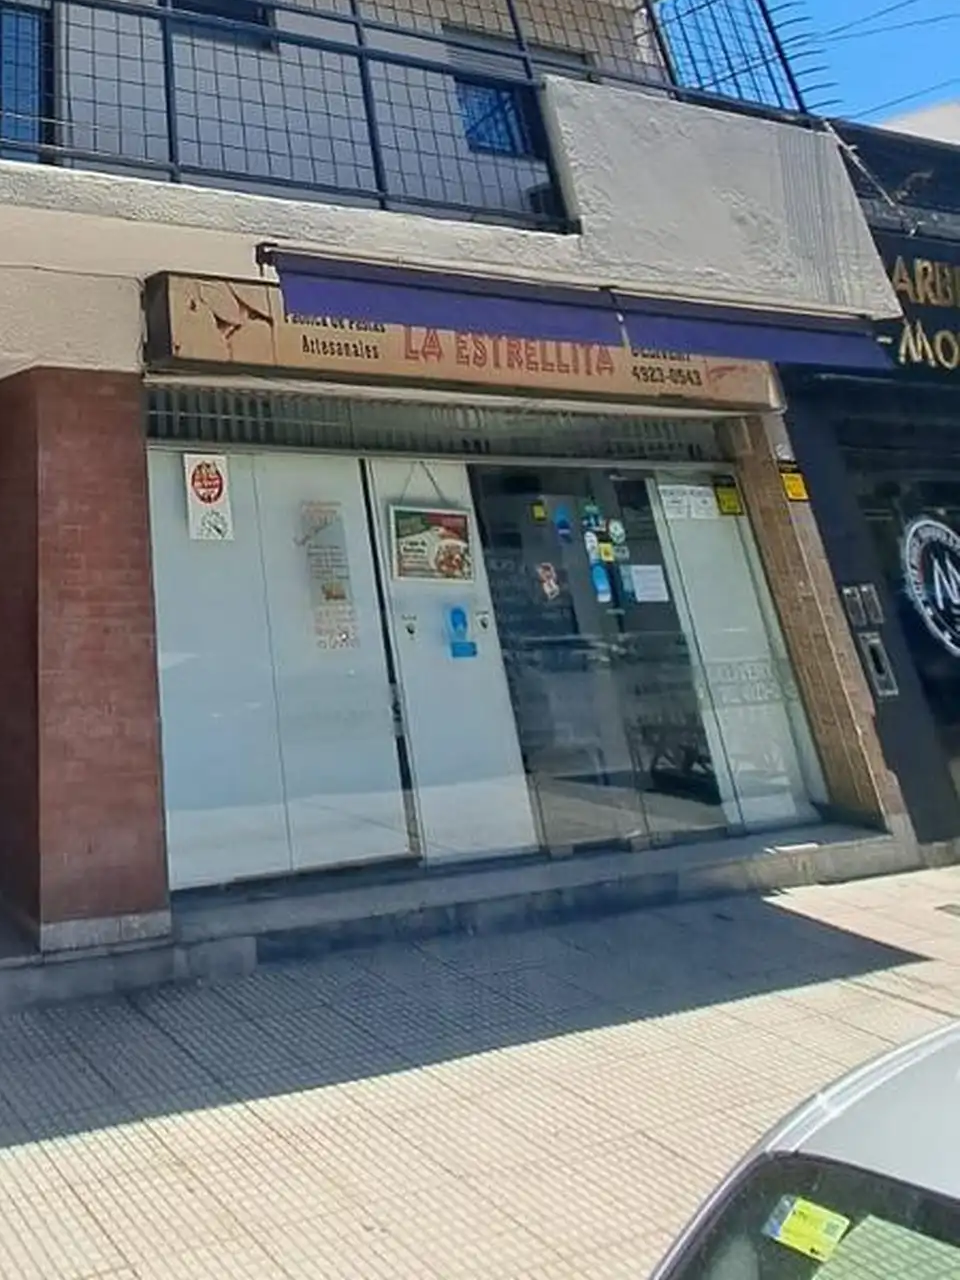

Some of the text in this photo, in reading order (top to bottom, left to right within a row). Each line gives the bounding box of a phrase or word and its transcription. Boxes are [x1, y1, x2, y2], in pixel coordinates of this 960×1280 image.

[301, 333, 380, 360] Artesanales
[404, 323, 615, 376] LA ESTRELLITA
